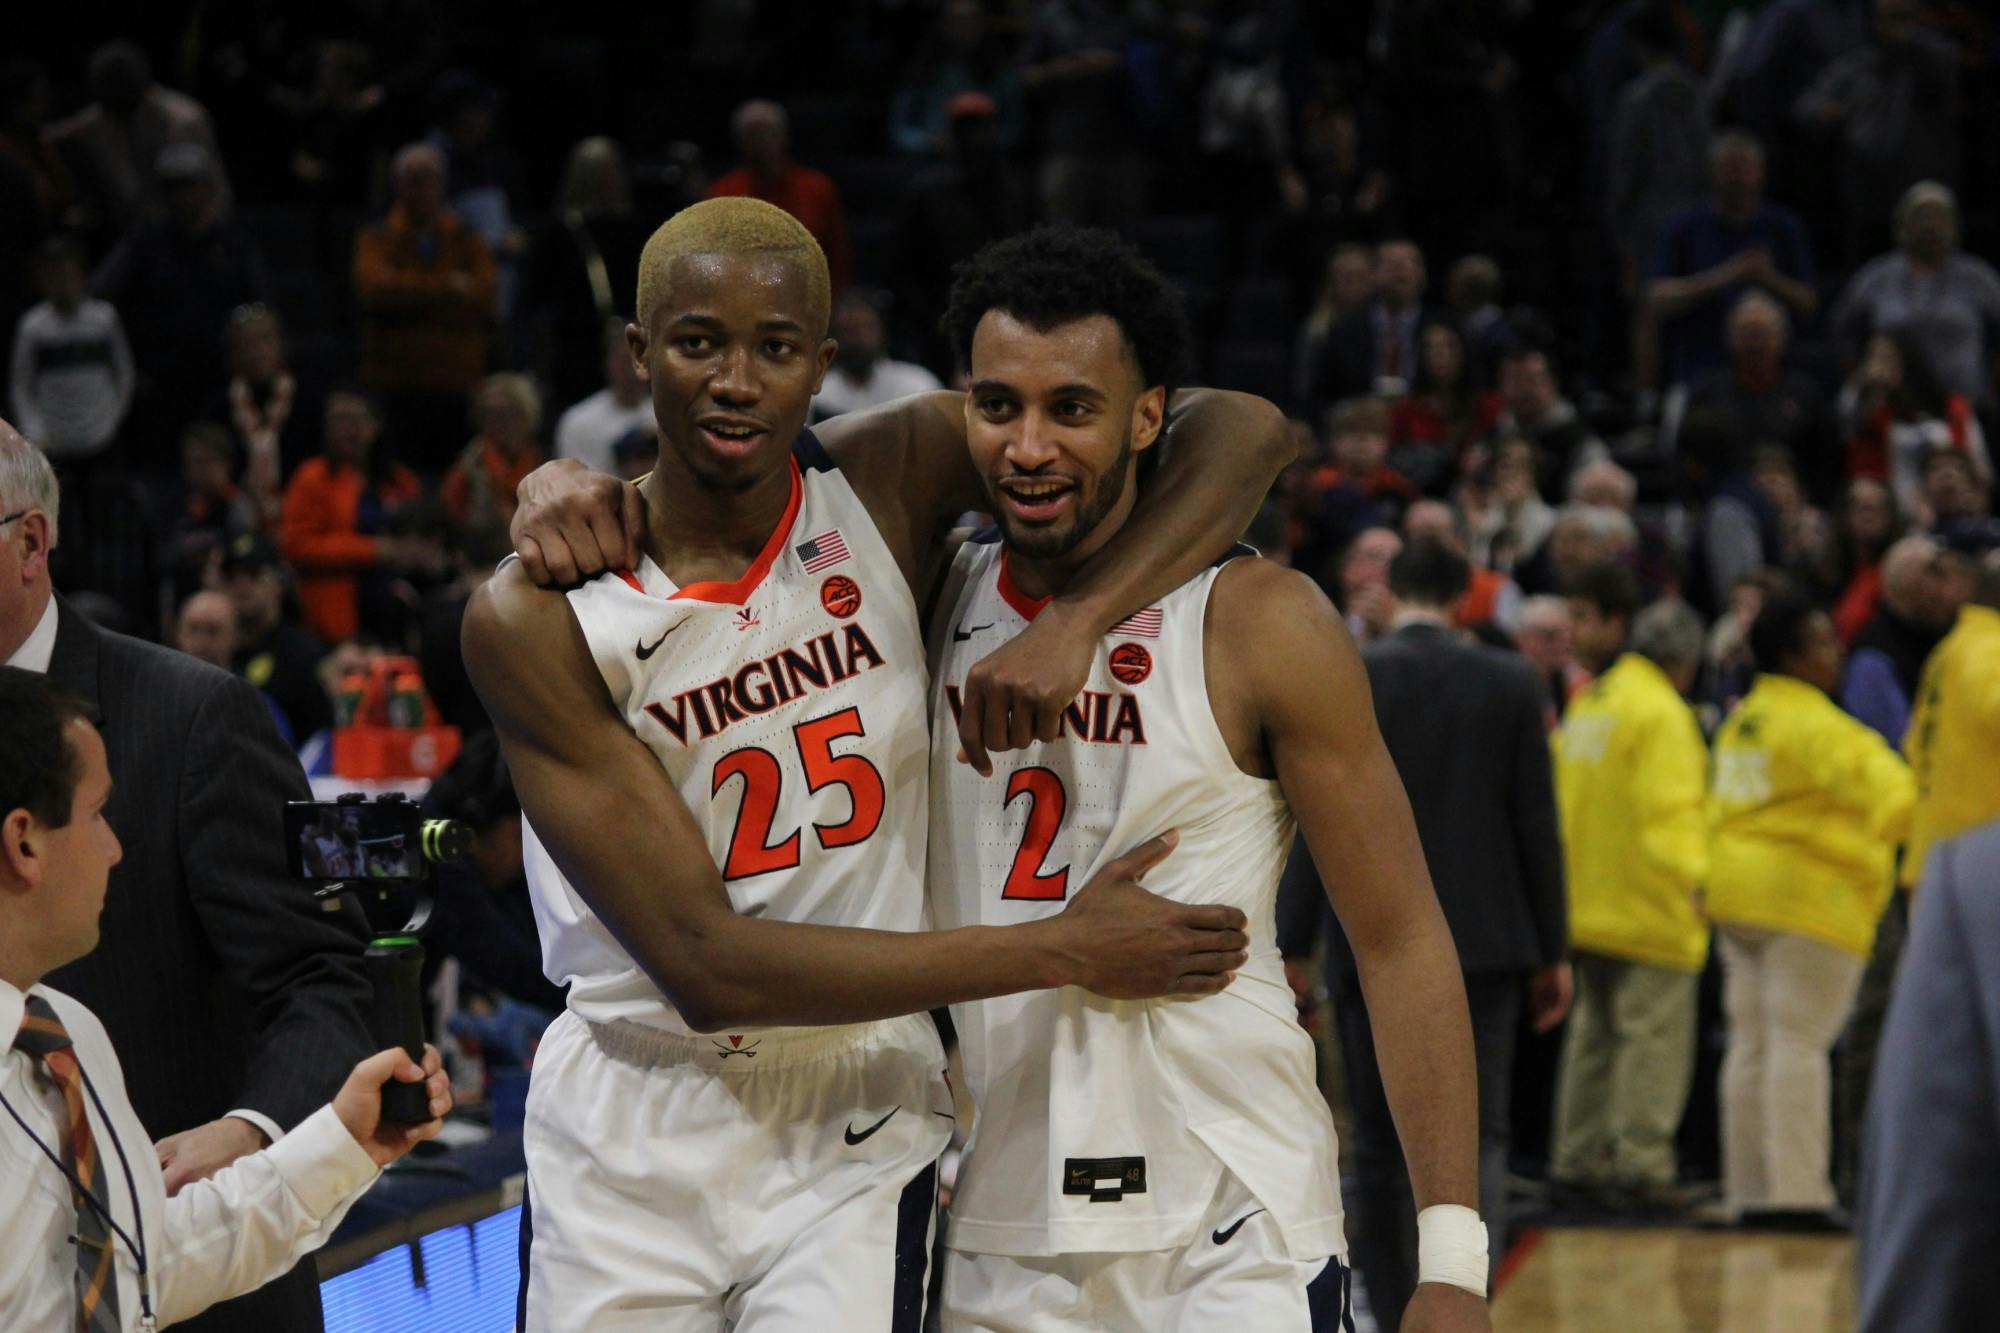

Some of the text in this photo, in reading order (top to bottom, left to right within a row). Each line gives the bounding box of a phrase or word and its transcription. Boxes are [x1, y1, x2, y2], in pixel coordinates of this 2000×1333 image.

[643, 622, 886, 748] VIRGINIA
[711, 706, 885, 882] 25
[1002, 766, 1071, 901] 2
